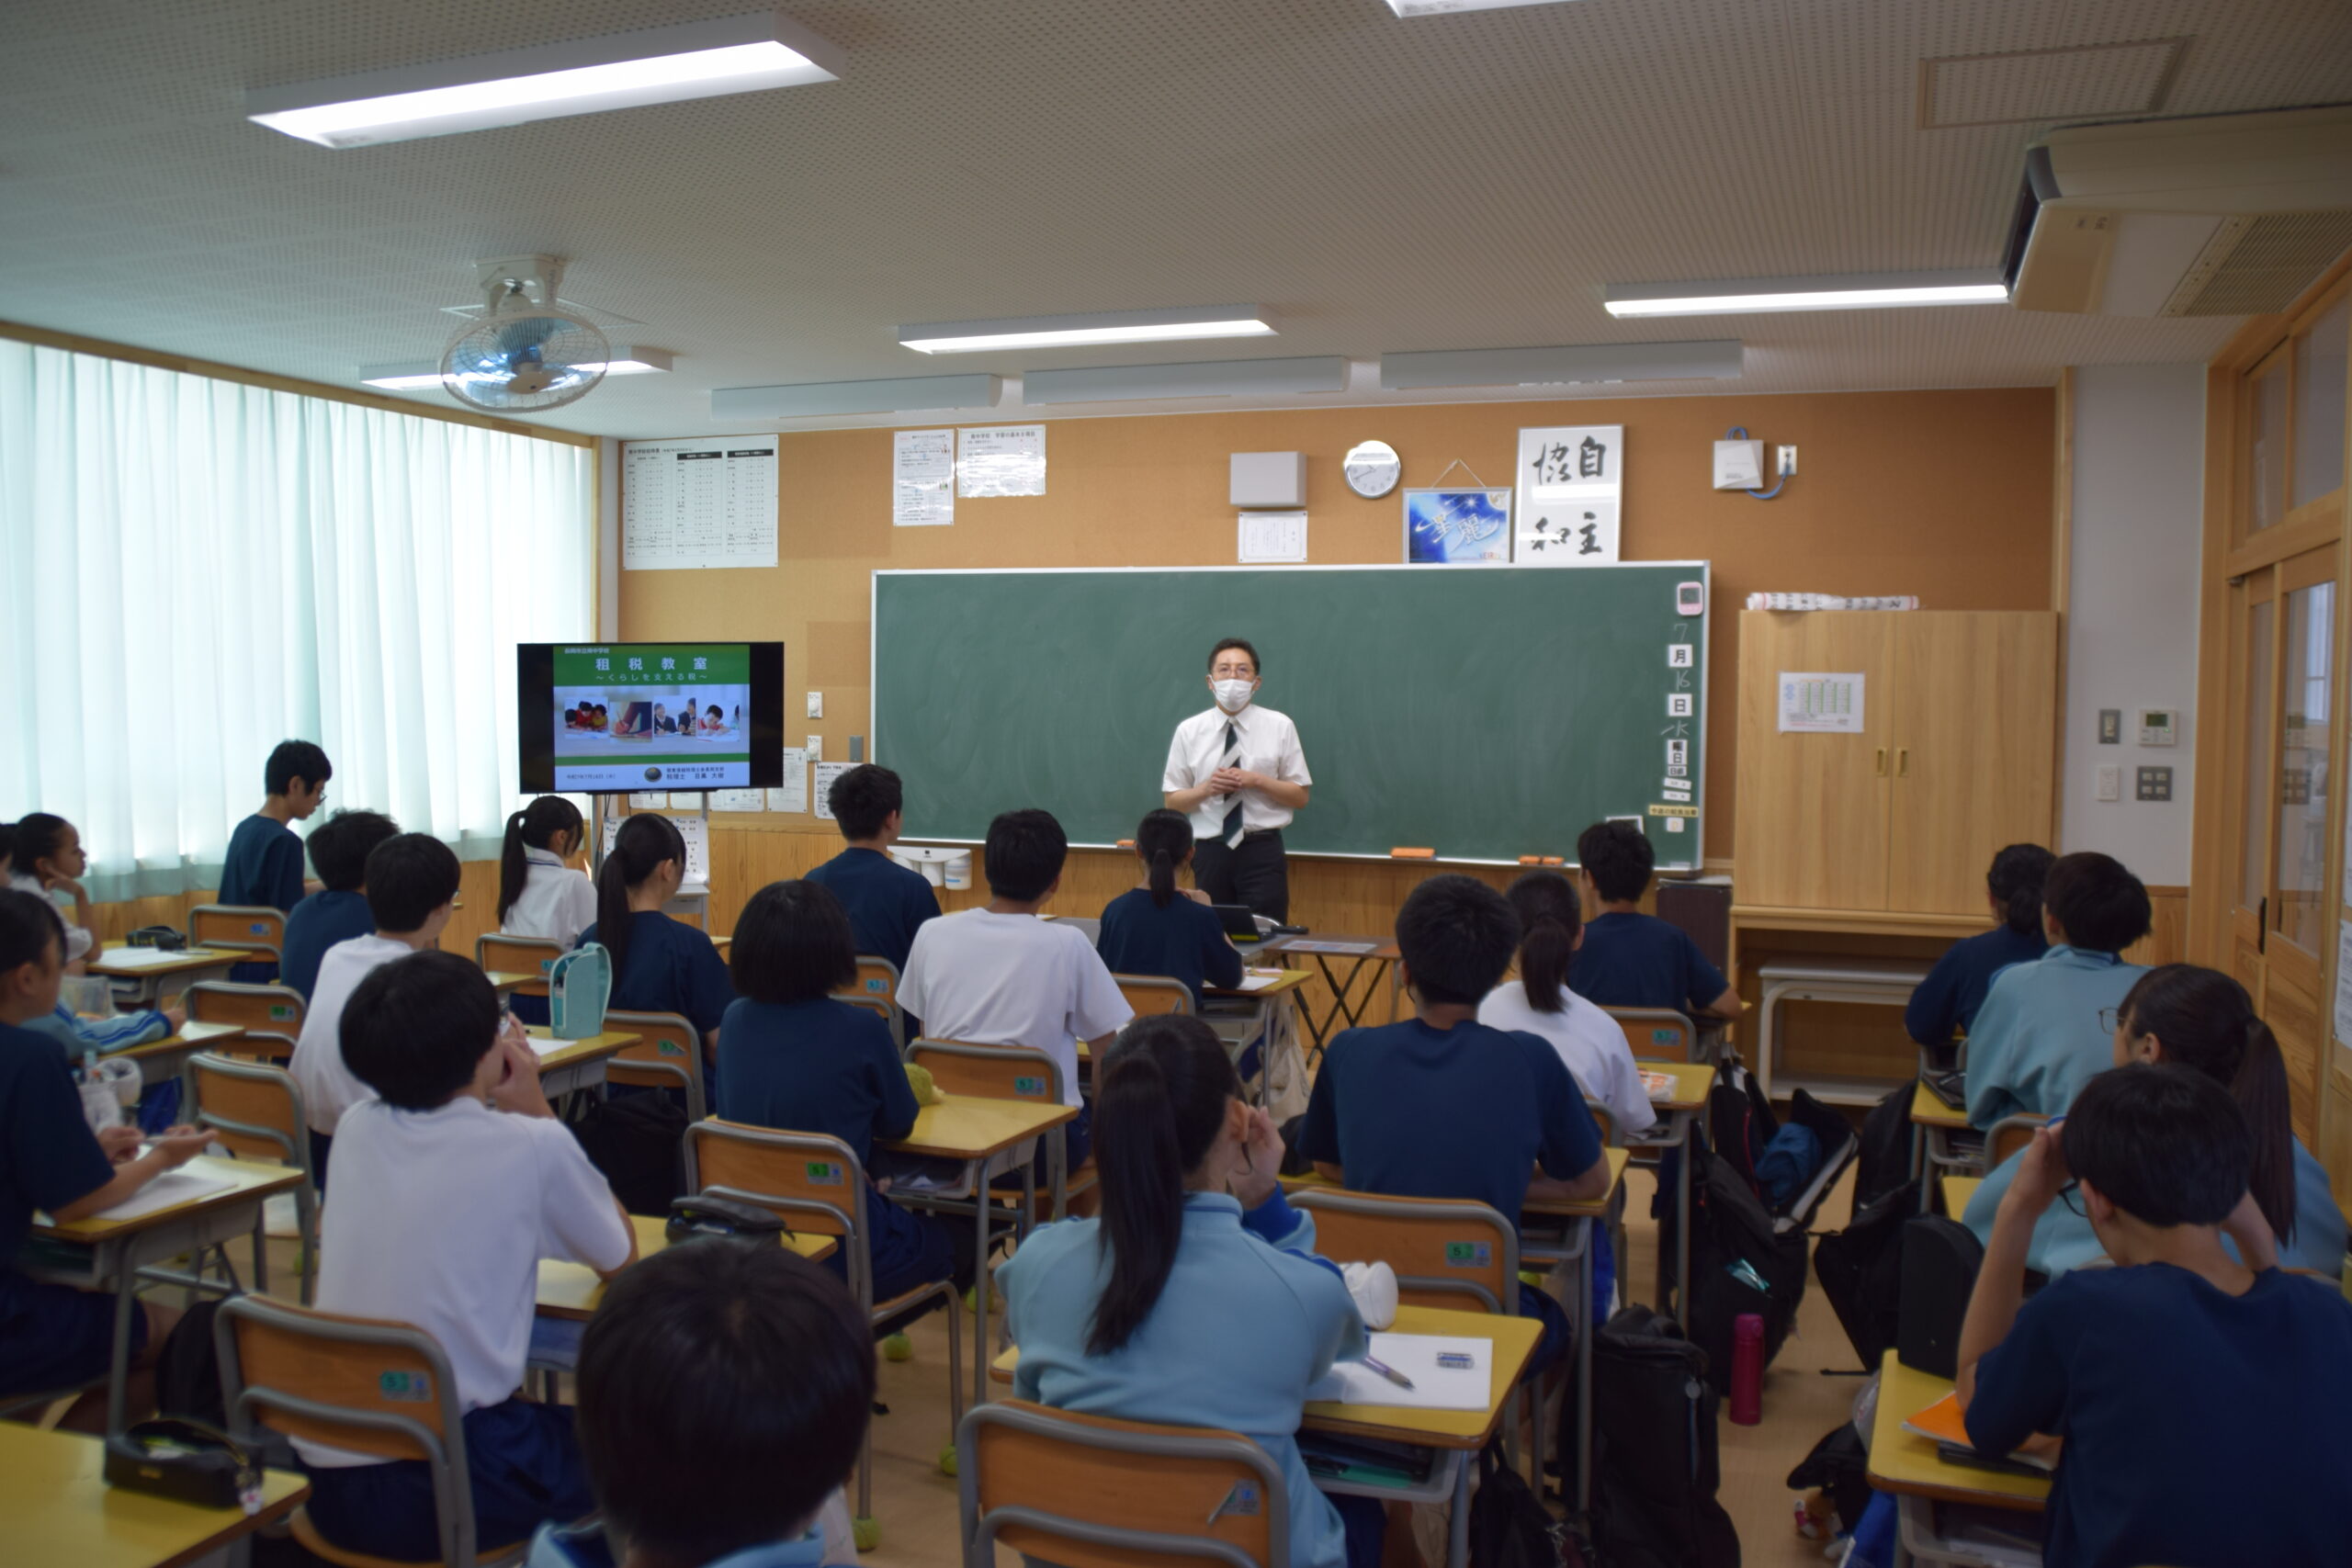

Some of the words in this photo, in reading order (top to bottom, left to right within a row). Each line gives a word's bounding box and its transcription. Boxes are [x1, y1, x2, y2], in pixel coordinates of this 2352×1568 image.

[1578, 434, 1606, 556] 自主
[1674, 649, 1686, 663] 月
[1676, 670, 1691, 692] 16
[1674, 698, 1686, 713] 日
